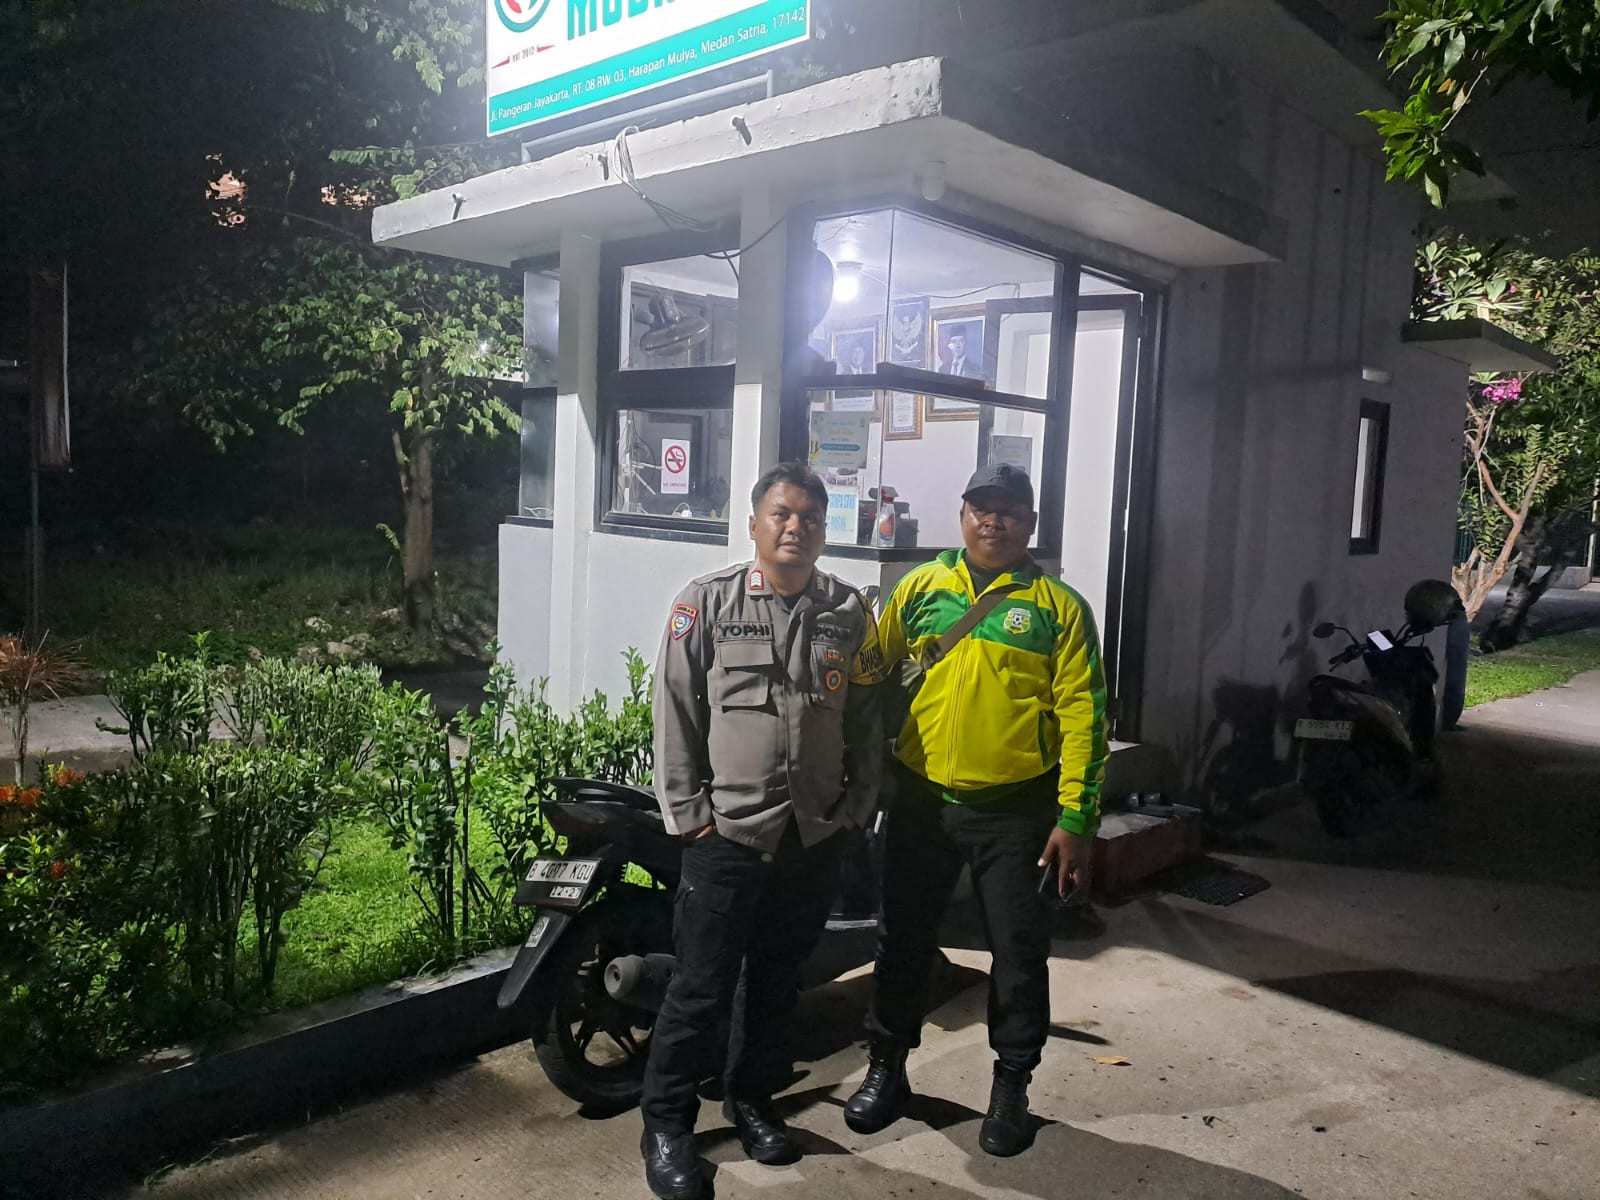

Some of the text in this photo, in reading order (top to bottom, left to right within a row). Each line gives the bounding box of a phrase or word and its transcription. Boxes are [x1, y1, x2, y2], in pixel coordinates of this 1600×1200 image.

[498, 101, 532, 118] Pangeran
[534, 88, 570, 109] Jayakarta,
[572, 82, 584, 96] RT.
[585, 79, 595, 91] 08
[613, 69, 626, 82] 03,
[628, 58, 665, 77] Harapan
[667, 48, 697, 65] Mulya,
[701, 33, 734, 54] Medan
[737, 23, 768, 42] Satria,
[772, 7, 805, 29] 17142
[720, 623, 770, 637] YOPHI
[529, 863, 538, 878] B
